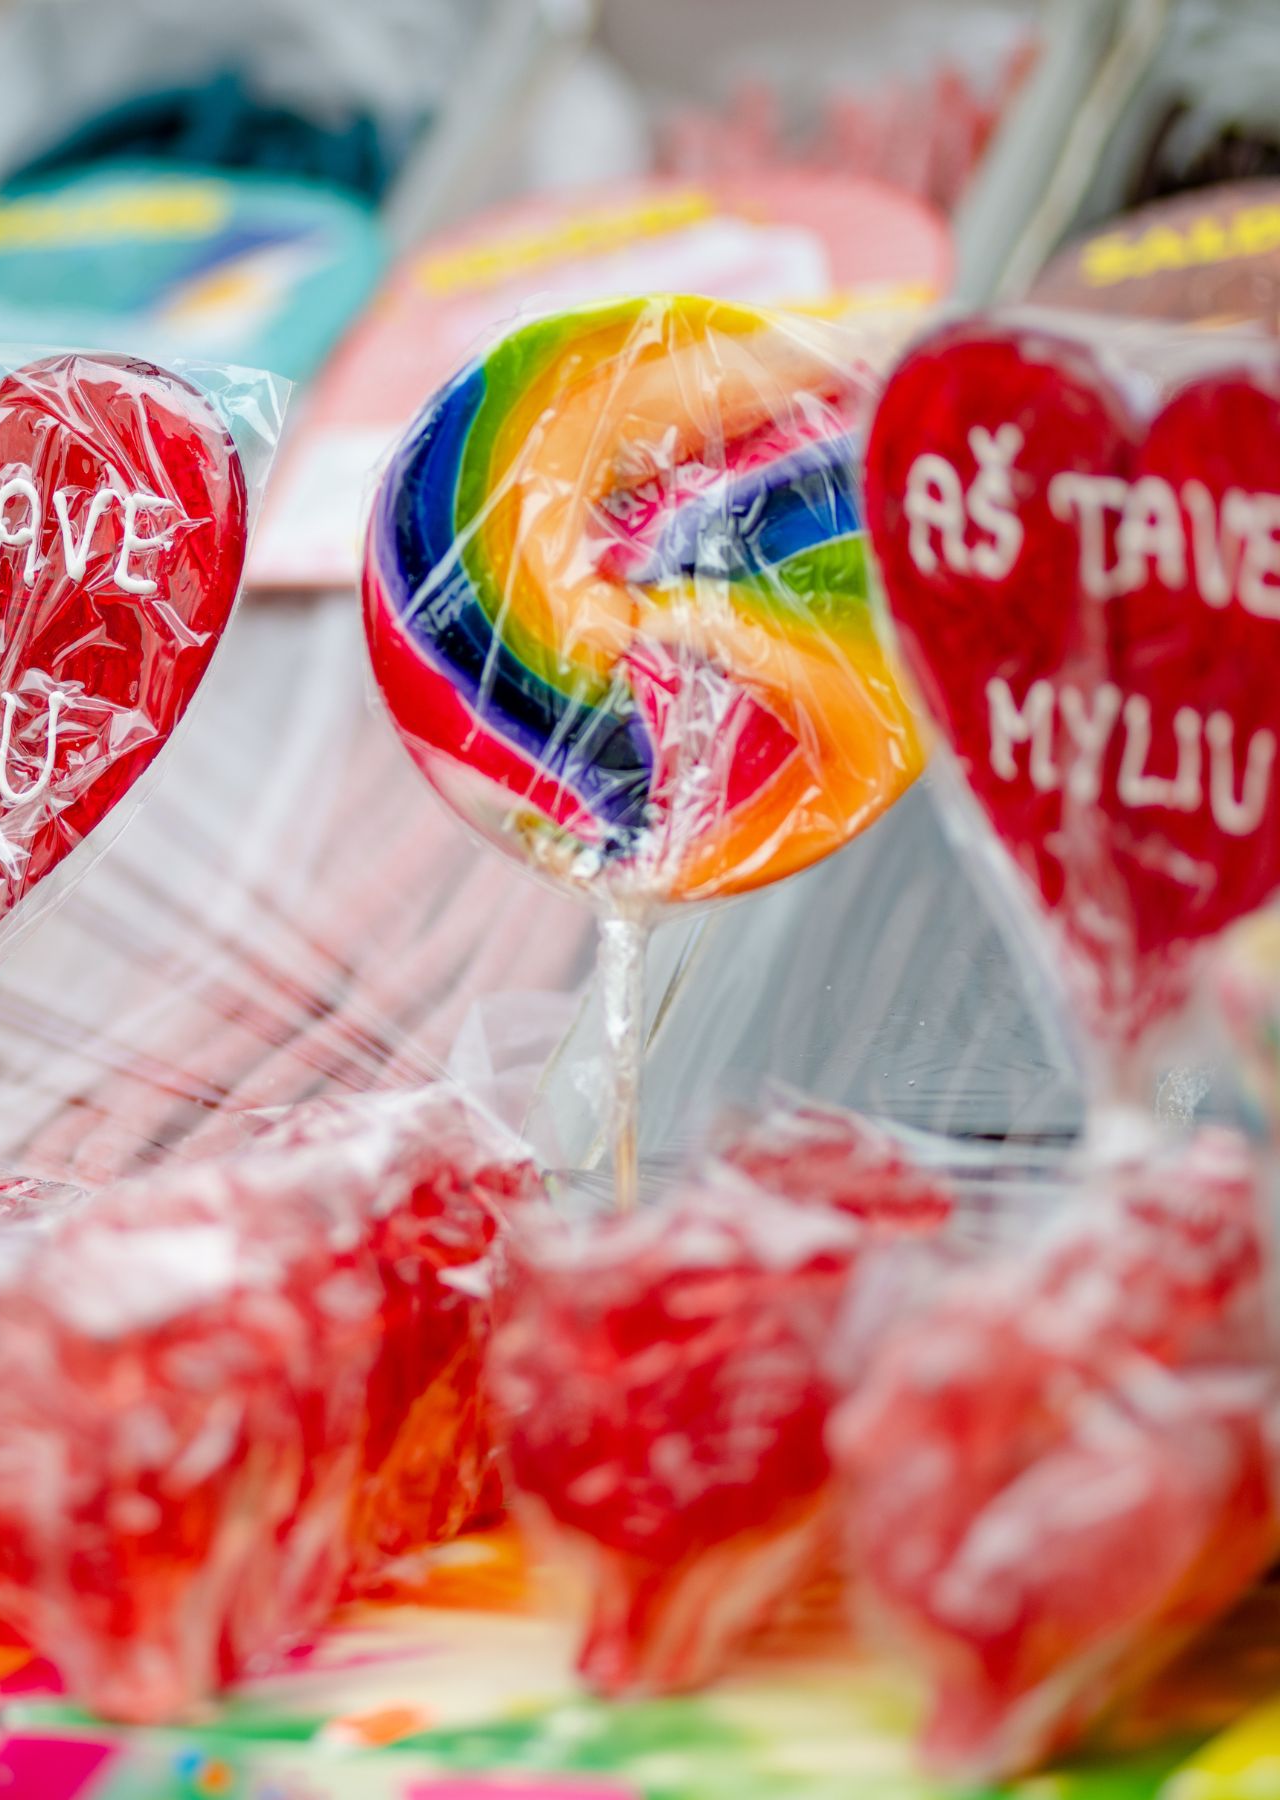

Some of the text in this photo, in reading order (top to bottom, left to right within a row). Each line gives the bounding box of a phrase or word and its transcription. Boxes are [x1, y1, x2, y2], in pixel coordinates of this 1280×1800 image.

[905, 423, 1280, 620] AŠ TAVE
[985, 677, 1276, 836] MYLIU
